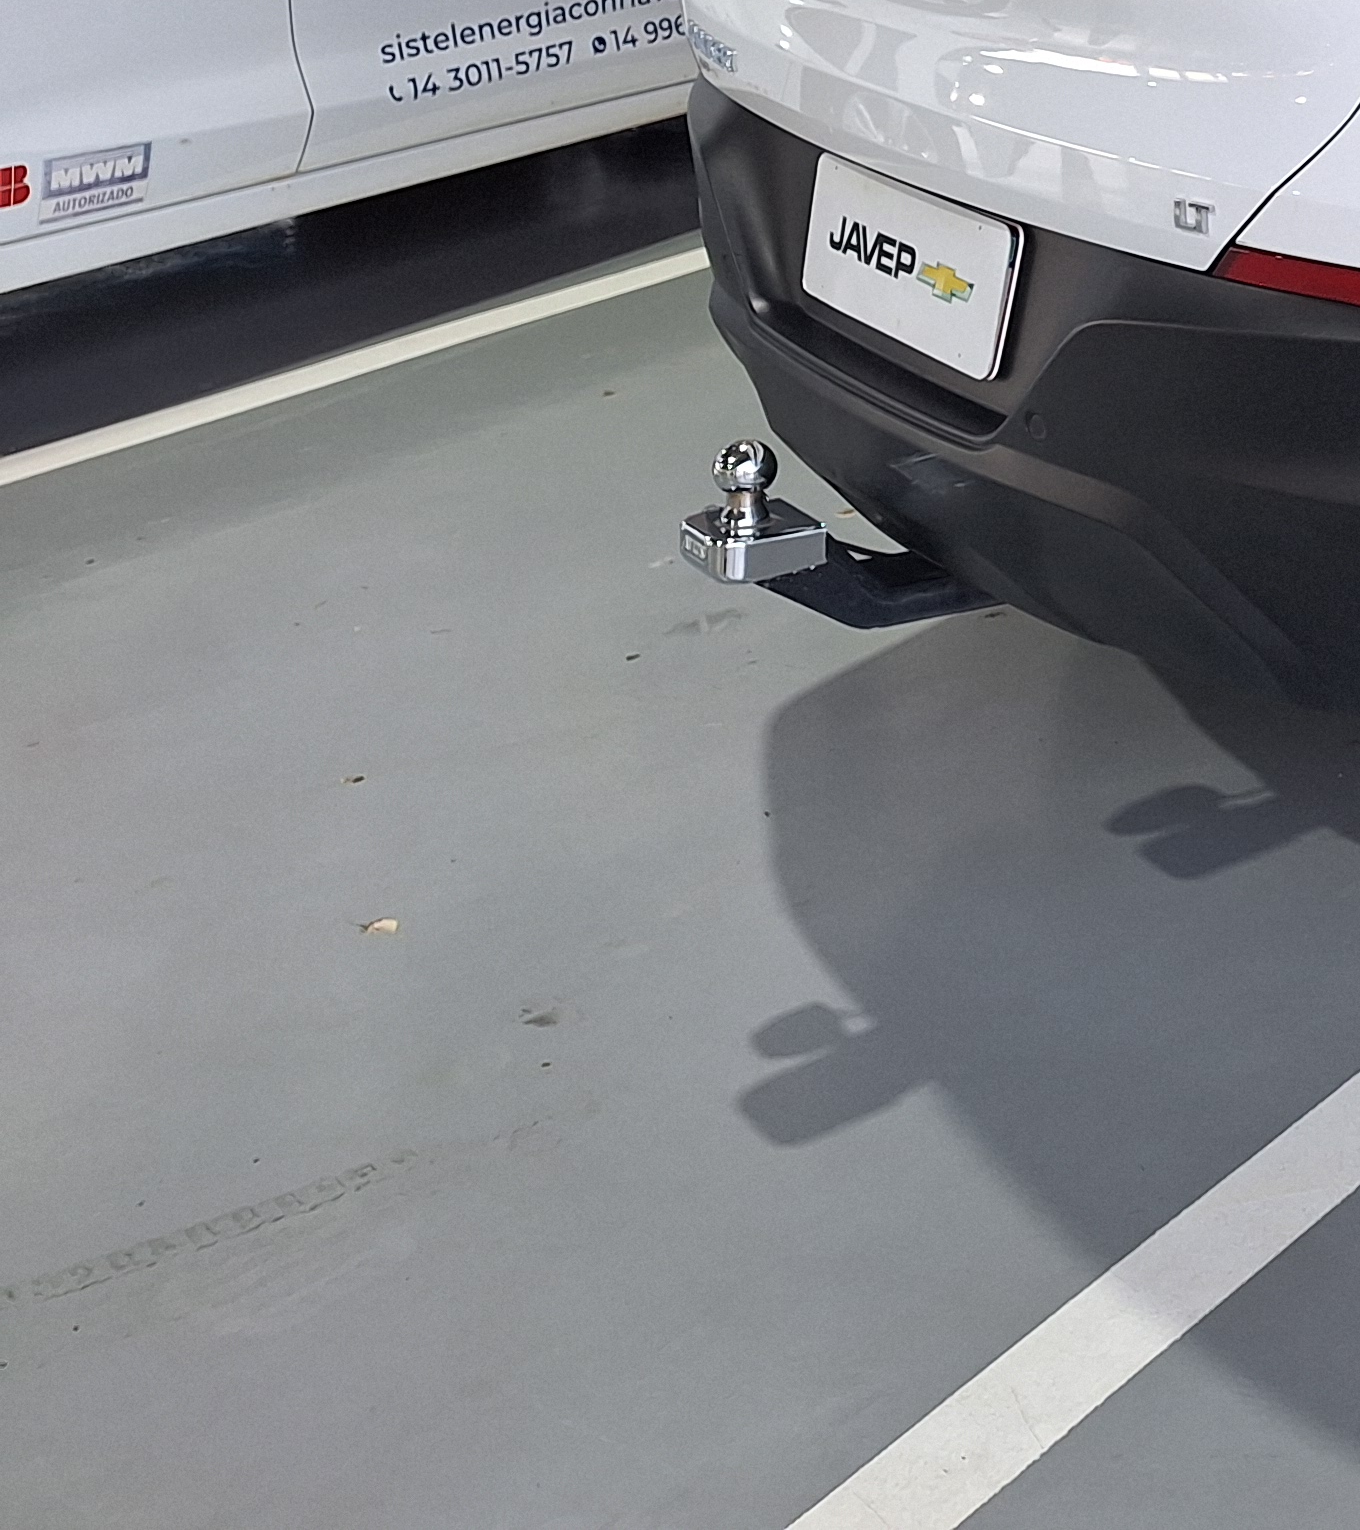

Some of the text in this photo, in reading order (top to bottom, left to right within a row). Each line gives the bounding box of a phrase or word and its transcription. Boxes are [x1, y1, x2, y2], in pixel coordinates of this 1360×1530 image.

[407, 73, 441, 100] 14
[447, 41, 574, 92] 3011-5757
[610, 26, 639, 51] 14
[51, 155, 144, 189] MWM
[53, 186, 134, 213] AUTORIZADO
[1174, 198, 1215, 234] LT
[829, 216, 916, 279] JAVEP
